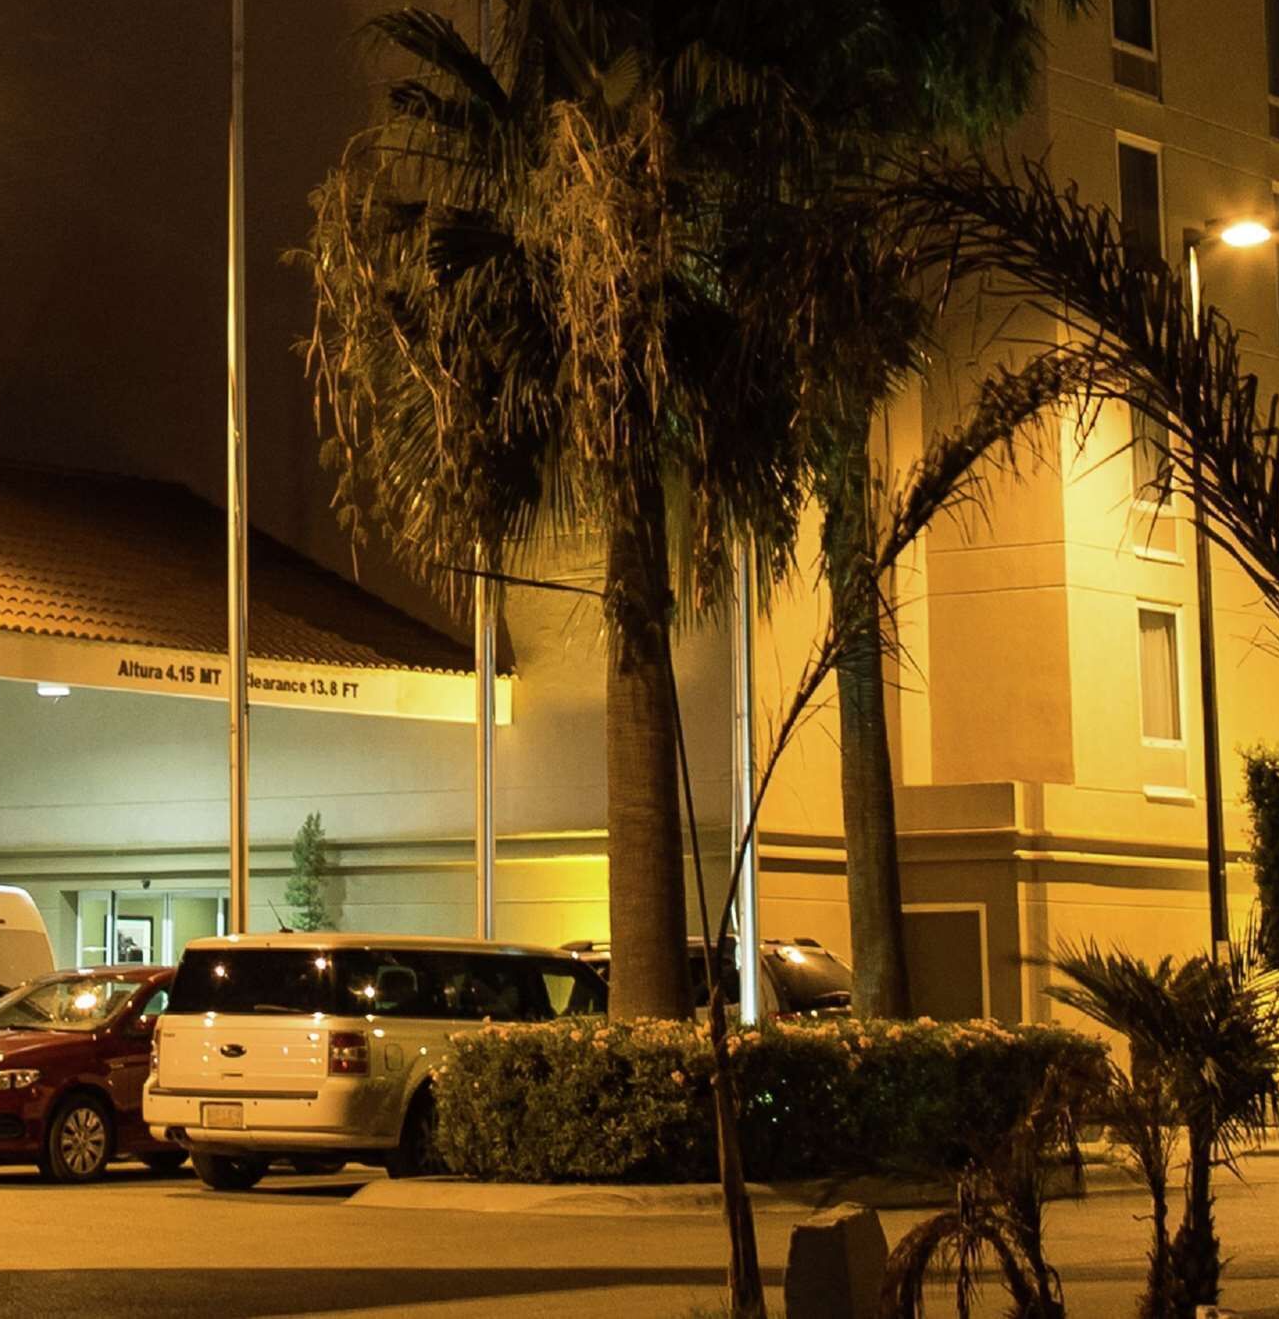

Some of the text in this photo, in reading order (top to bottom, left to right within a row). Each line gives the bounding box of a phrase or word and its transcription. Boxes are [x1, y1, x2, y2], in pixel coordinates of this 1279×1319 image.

[117, 660, 163, 680] Altura
[166, 664, 195, 683] 4.15
[200, 668, 222, 685] MT
[310, 679, 338, 697] 13.8
[342, 682, 359, 698] FT
